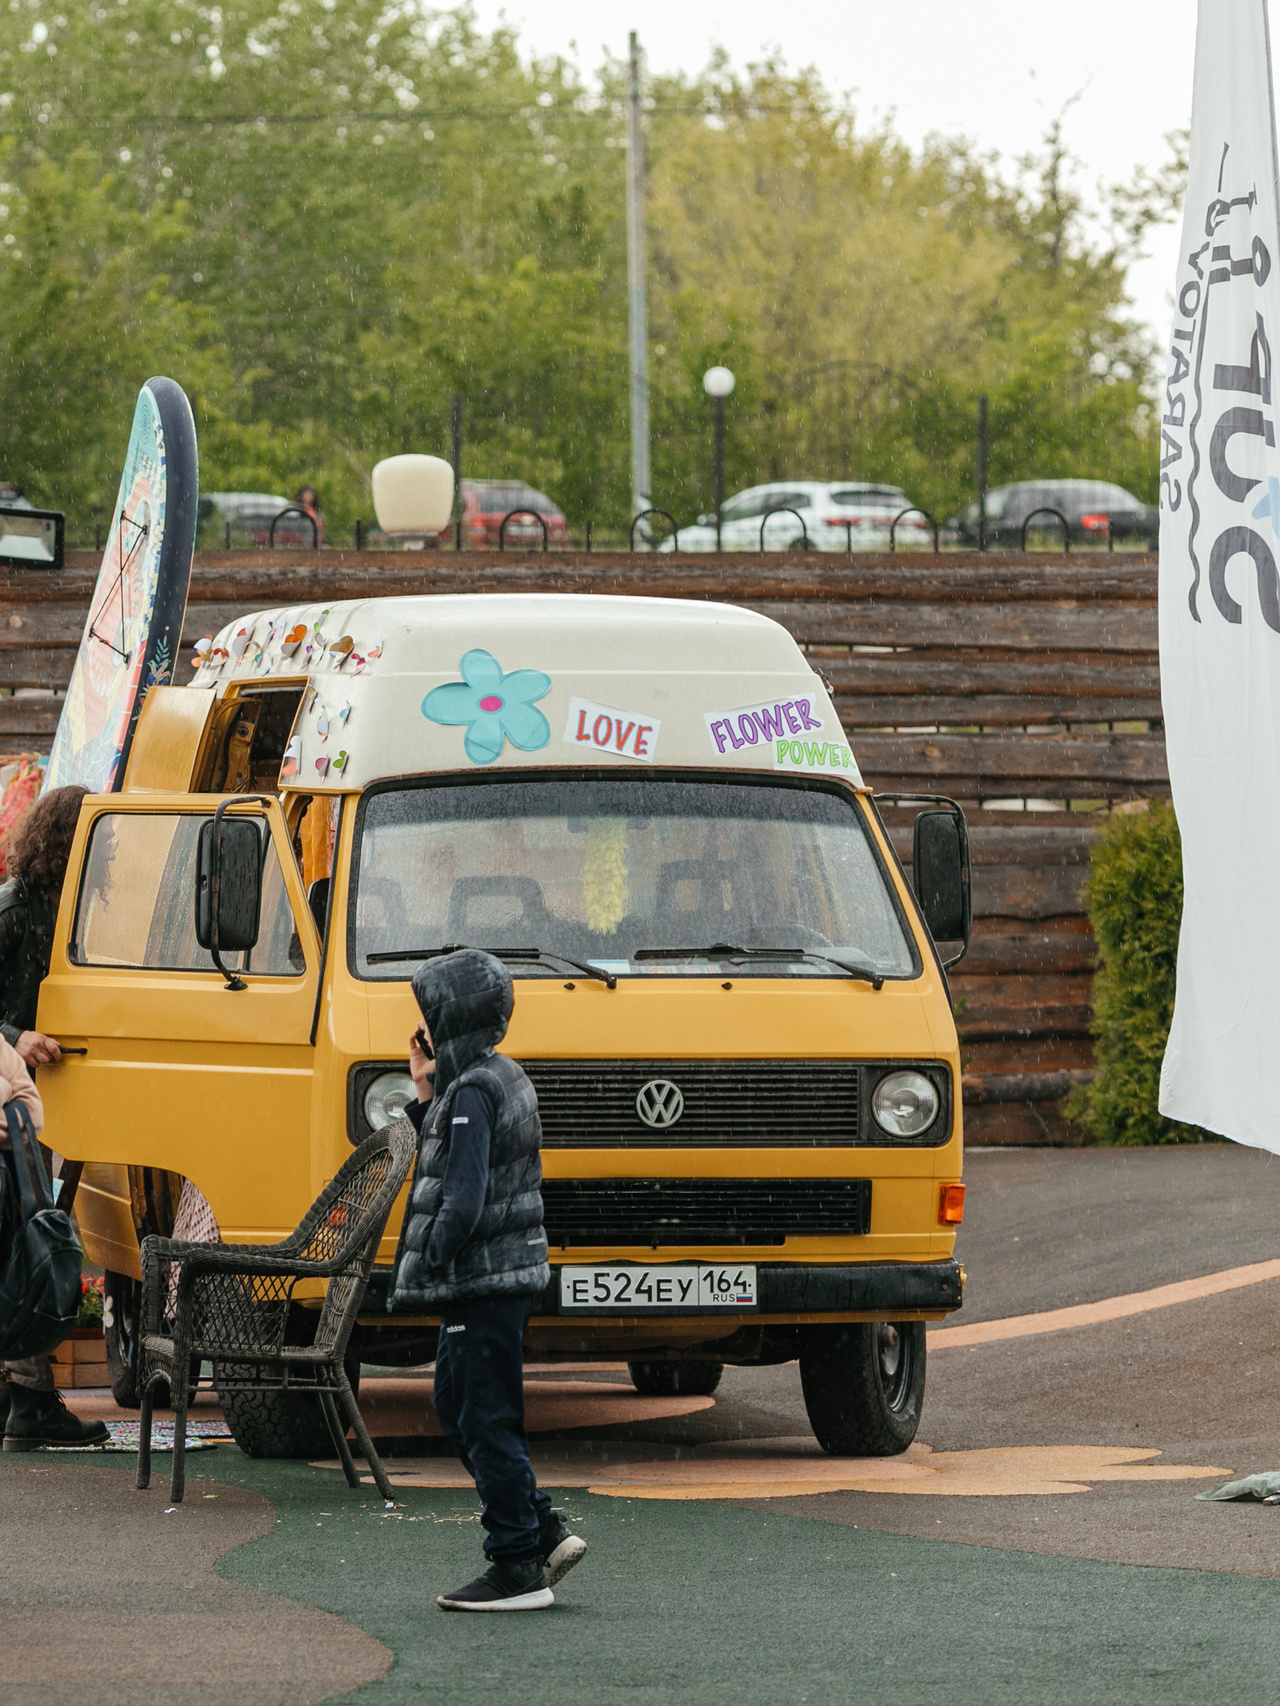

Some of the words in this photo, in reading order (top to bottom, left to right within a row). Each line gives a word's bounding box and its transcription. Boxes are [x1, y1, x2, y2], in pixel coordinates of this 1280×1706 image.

[575, 709, 653, 756] LOVE
[710, 698, 822, 754] FLOWER
[776, 739, 856, 769] POWER
[702, 1269, 748, 1294] 164
[712, 1293, 736, 1303] RUS
